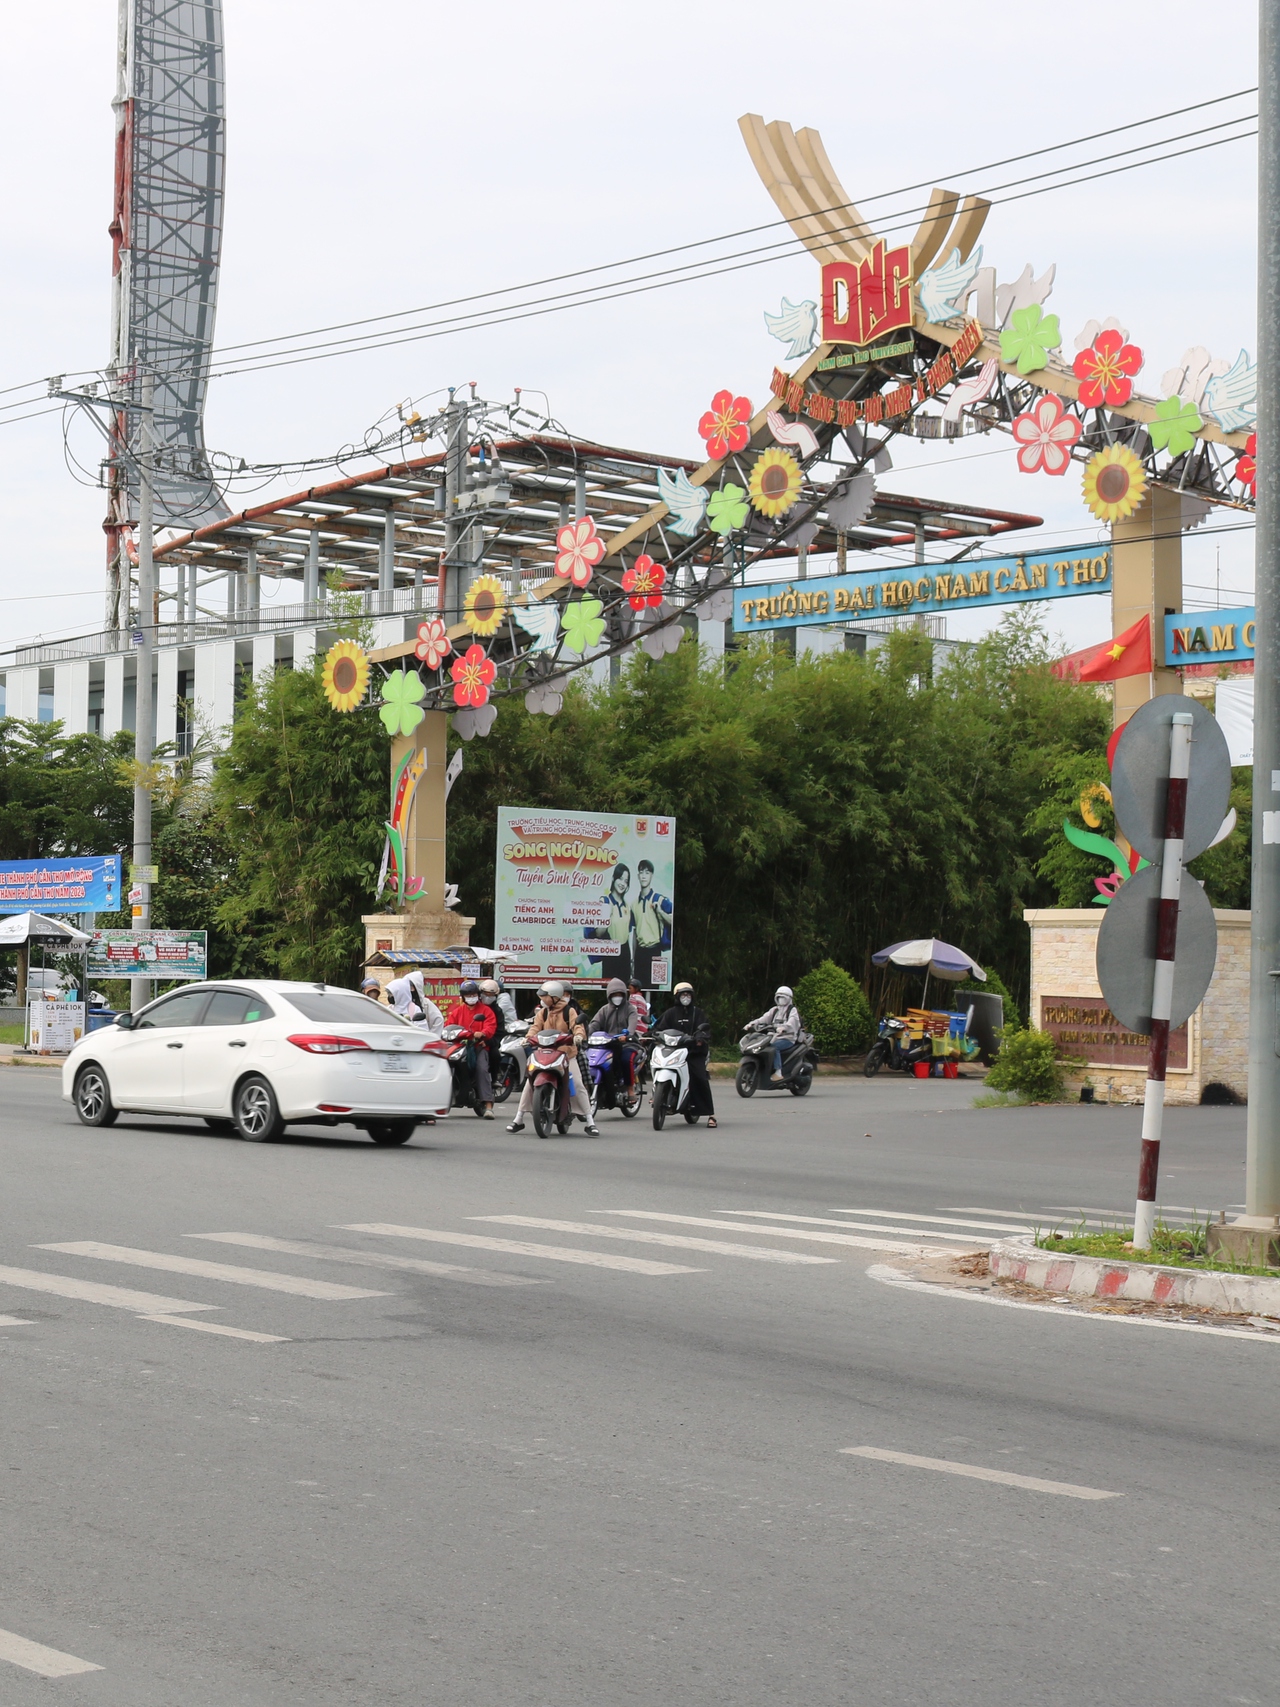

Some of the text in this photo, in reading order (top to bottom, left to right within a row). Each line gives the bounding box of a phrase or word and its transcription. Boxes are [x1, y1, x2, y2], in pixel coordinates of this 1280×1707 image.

[821, 238, 914, 346] DNC
[818, 358, 836, 371] NAM
[854, 350, 869, 364] THO
[870, 340, 915, 361] UNIVERSITY
[741, 551, 1109, 623] TRƯỜNG ĐẠI HỌC NAM CẦN THƠ
[1172, 623, 1236, 655] NAM
[507, 818, 533, 827] TRƯỜNG
[564, 818, 584, 827] TRUNG
[585, 821, 598, 829] HỌC
[553, 827, 567, 835] HỌC
[581, 828, 602, 838] THÔNG
[503, 839, 619, 865] SONG NGỮ DNC
[516, 867, 604, 889] Tuyển Sinh Lớp 10
[70, 885, 85, 899] 2024
[514, 903, 554, 914] TIẾNG ANH
[572, 908, 601, 917] ĐẠI HỌC
[512, 916, 556, 925] CAMBRIDGE
[596, 918, 611, 926] THƠ
[512, 944, 534, 953] DẠNG
[540, 943, 574, 955] HIỆN ĐẠI
[600, 945, 619, 955] ĐỘNG
